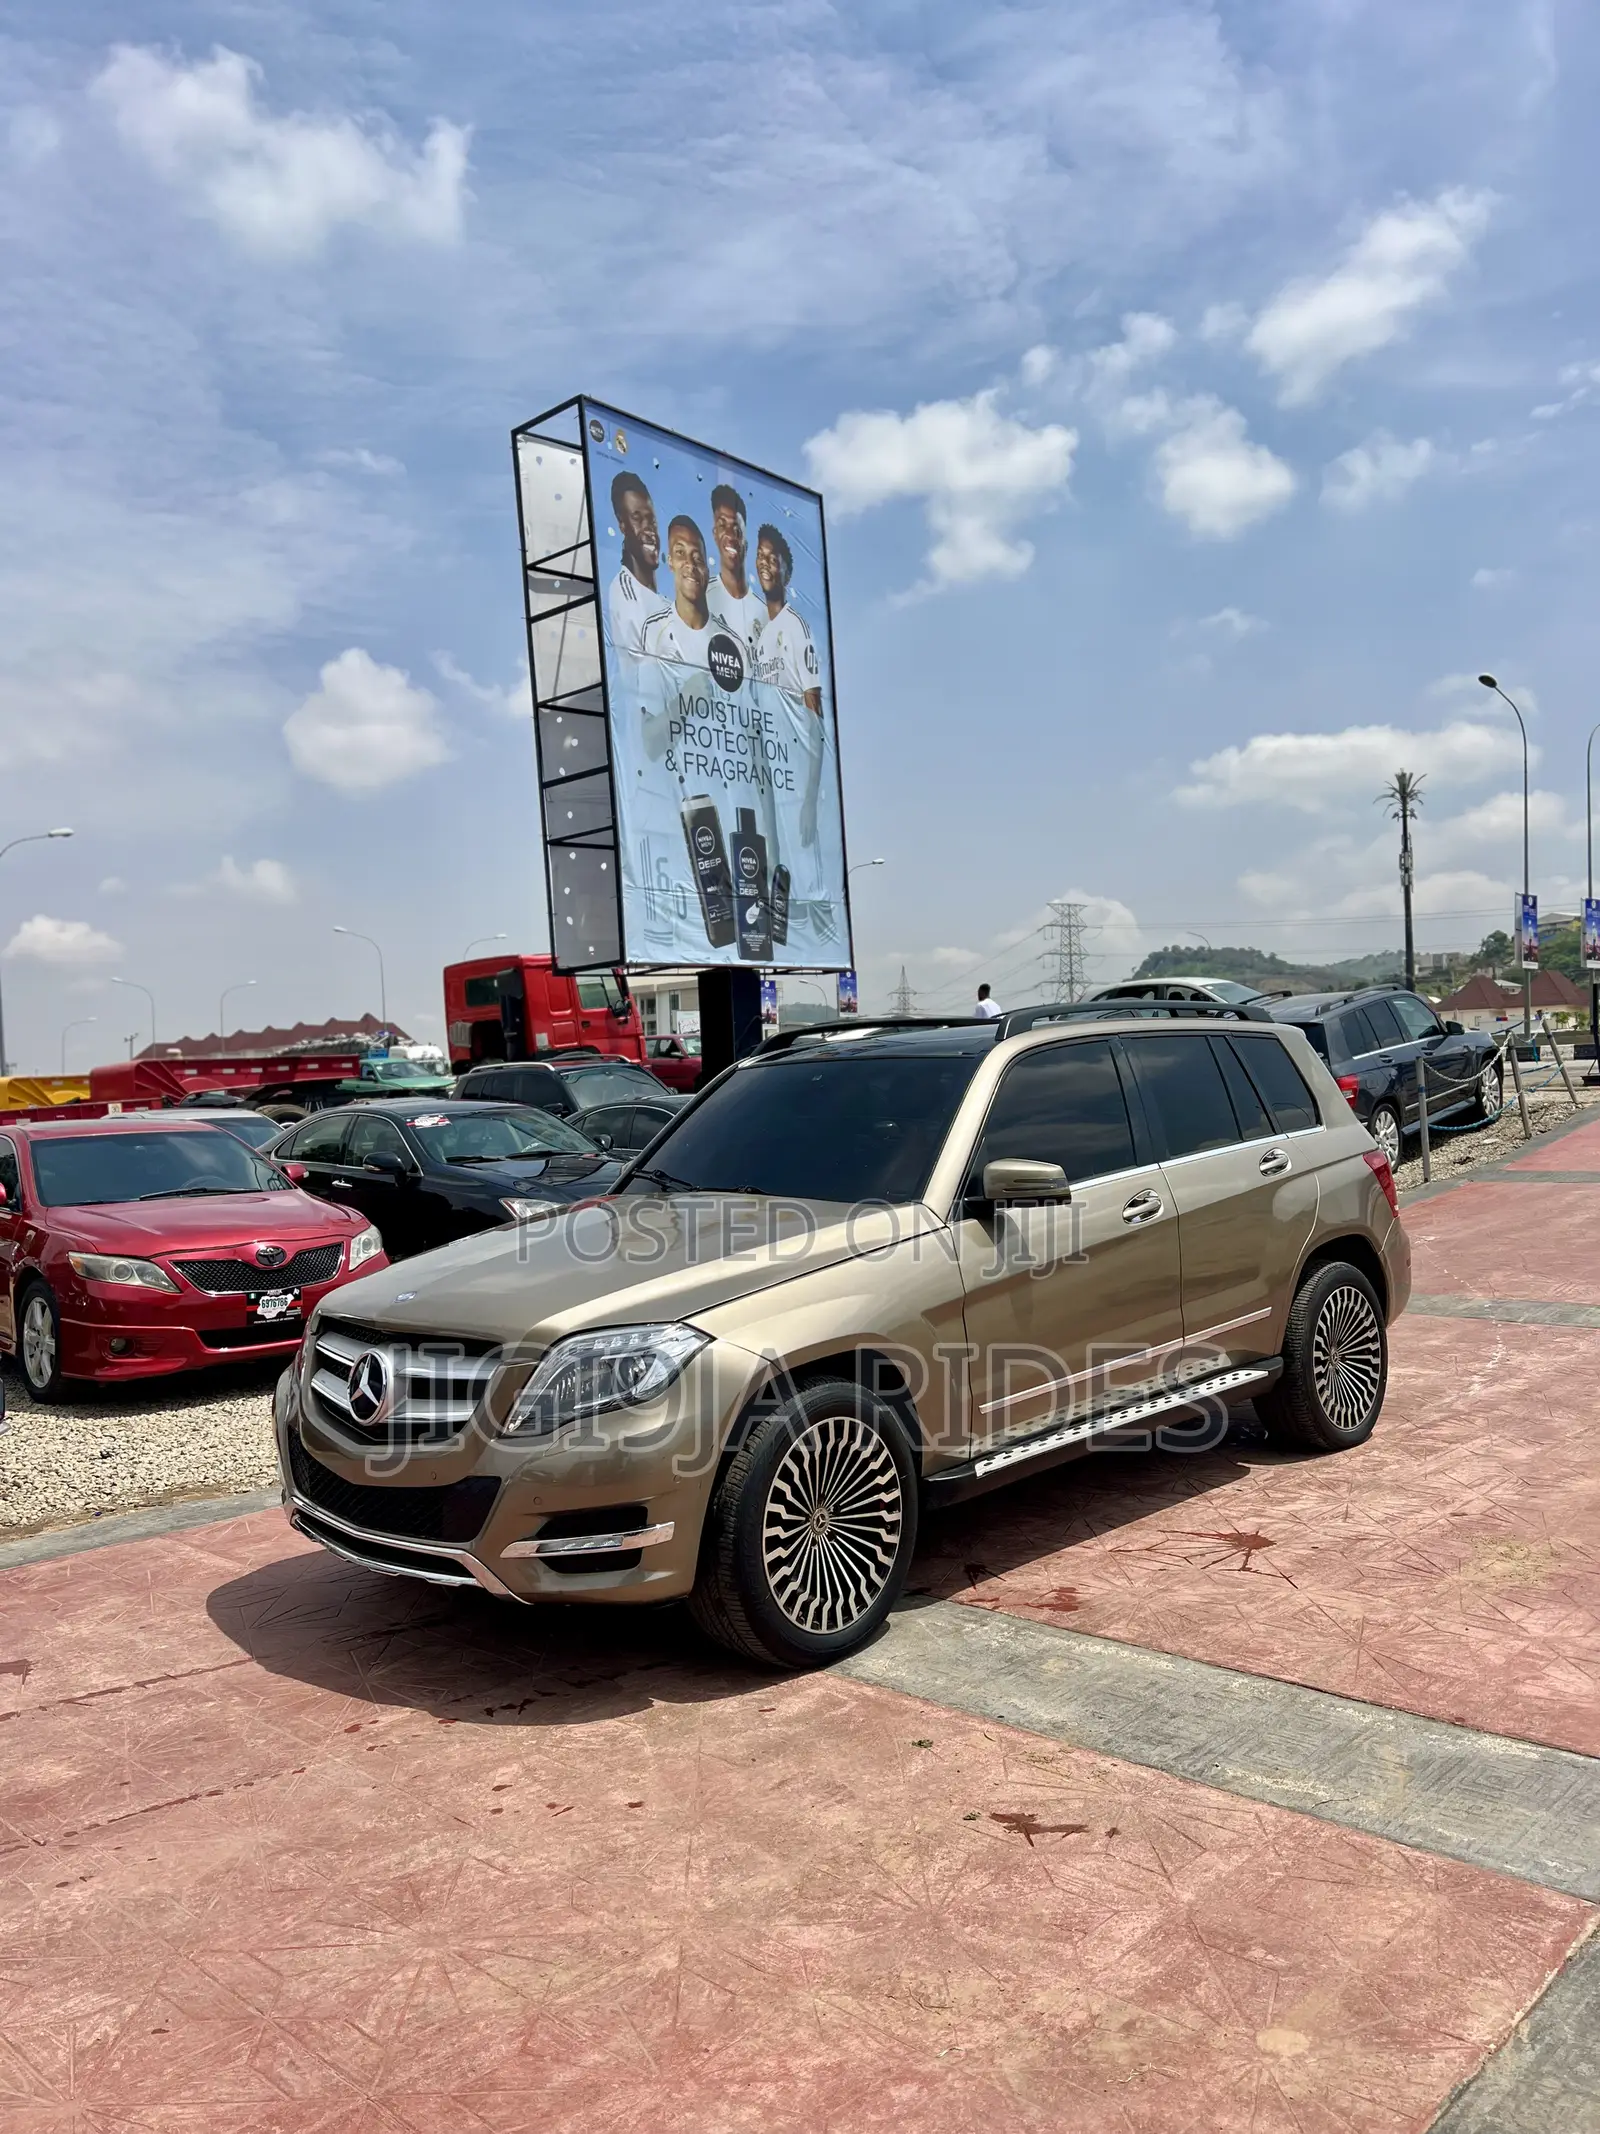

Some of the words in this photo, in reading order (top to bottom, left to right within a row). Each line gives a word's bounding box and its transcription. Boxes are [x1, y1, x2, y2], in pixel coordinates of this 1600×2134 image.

[710, 650, 741, 669] NIVEA
[716, 665, 738, 679] MEN
[679, 693, 778, 738] MOISTURE,
[669, 720, 788, 763] PROTECTION
[665, 749, 678, 772] &
[683, 752, 795, 791] FRAGRANCE
[698, 858, 721, 870] DEEP
[739, 887, 759, 896] DEEP
